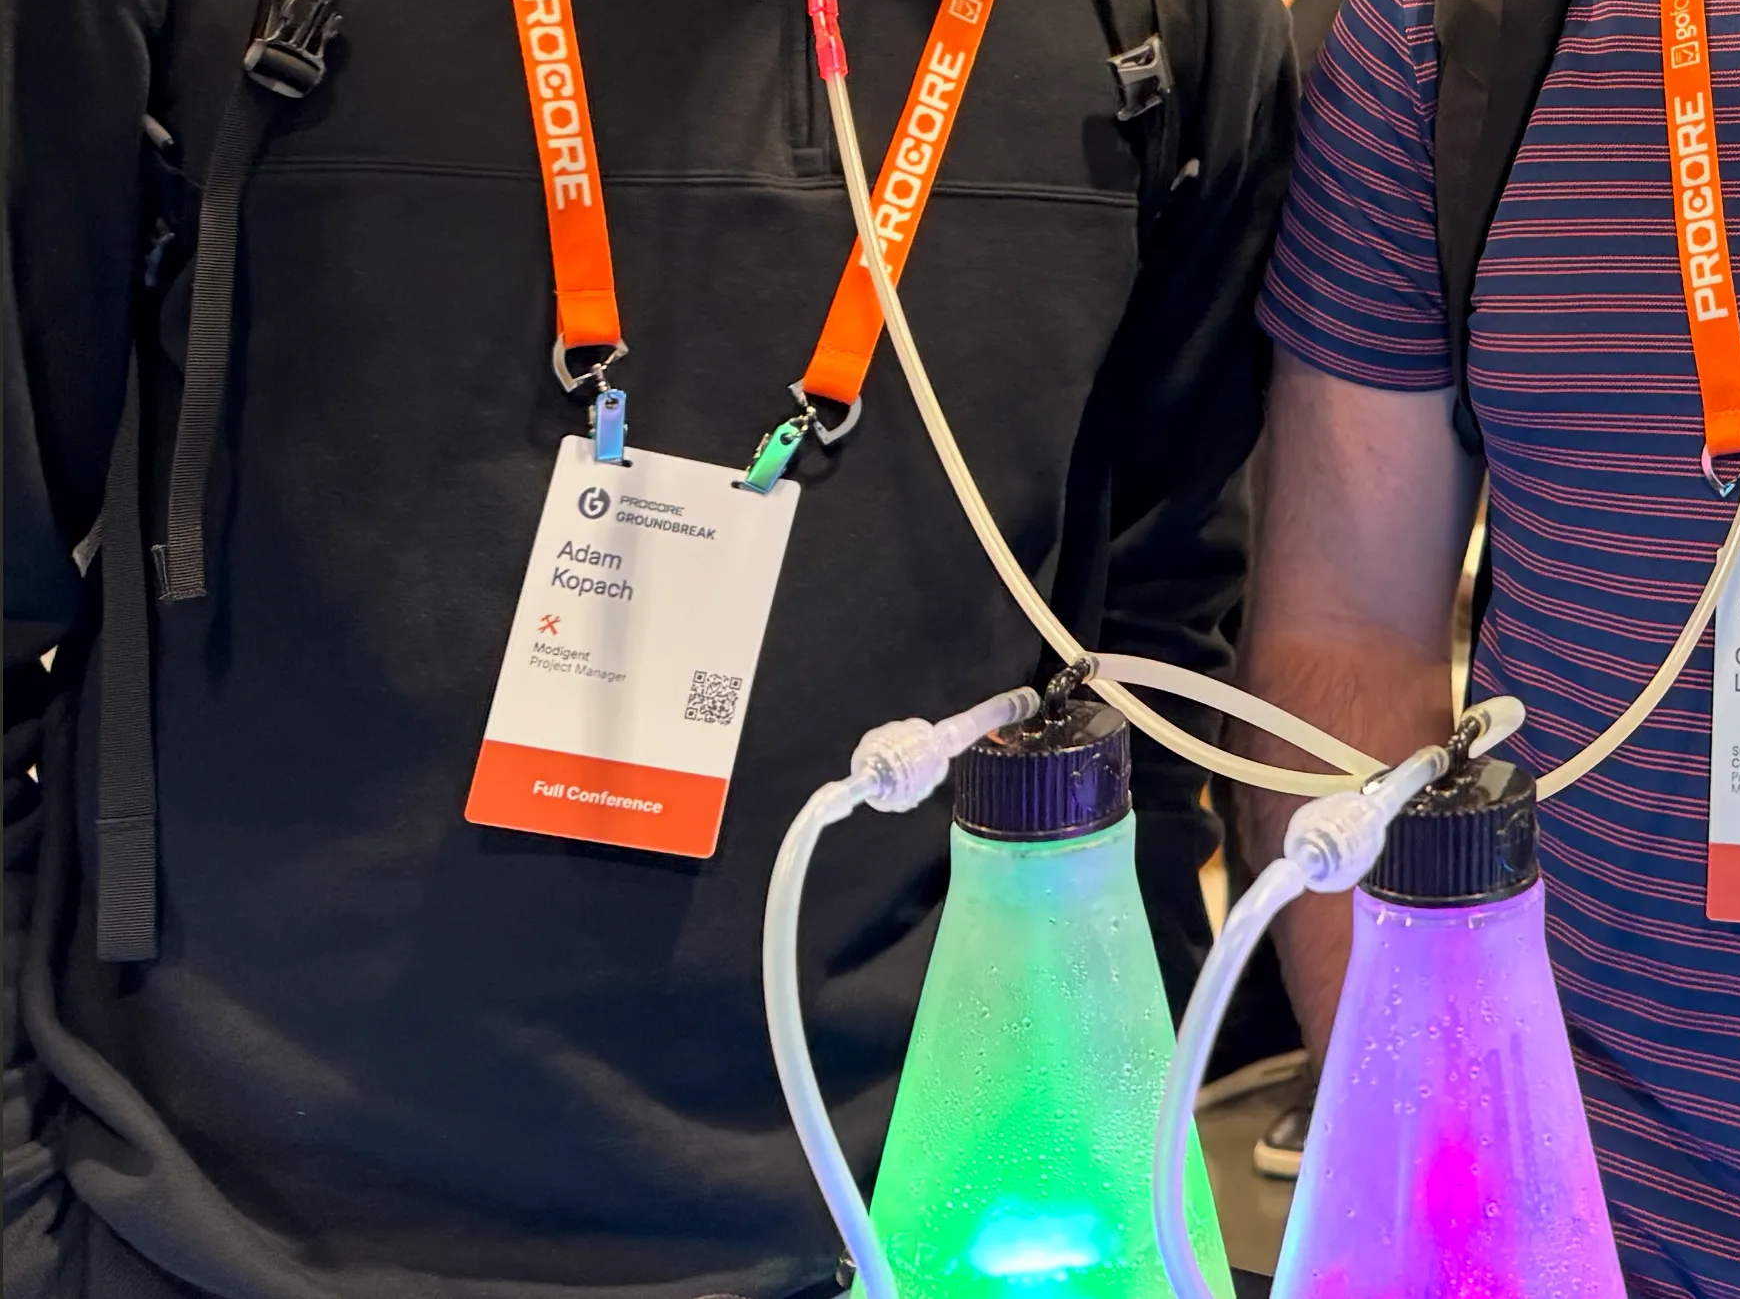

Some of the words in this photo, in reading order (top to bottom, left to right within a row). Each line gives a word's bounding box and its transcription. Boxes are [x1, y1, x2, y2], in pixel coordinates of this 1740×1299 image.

[1672, 91, 1729, 323] PROCORE
[619, 494, 685, 517] PROCORE
[616, 511, 717, 541] GROUNDBREAK
[557, 540, 623, 571] Adam
[551, 567, 634, 602] Kopach
[533, 641, 591, 662] Modigent
[529, 656, 572, 675] Project
[574, 663, 627, 684] Manager
[532, 779, 564, 799] Full
[566, 783, 663, 814] Conference
